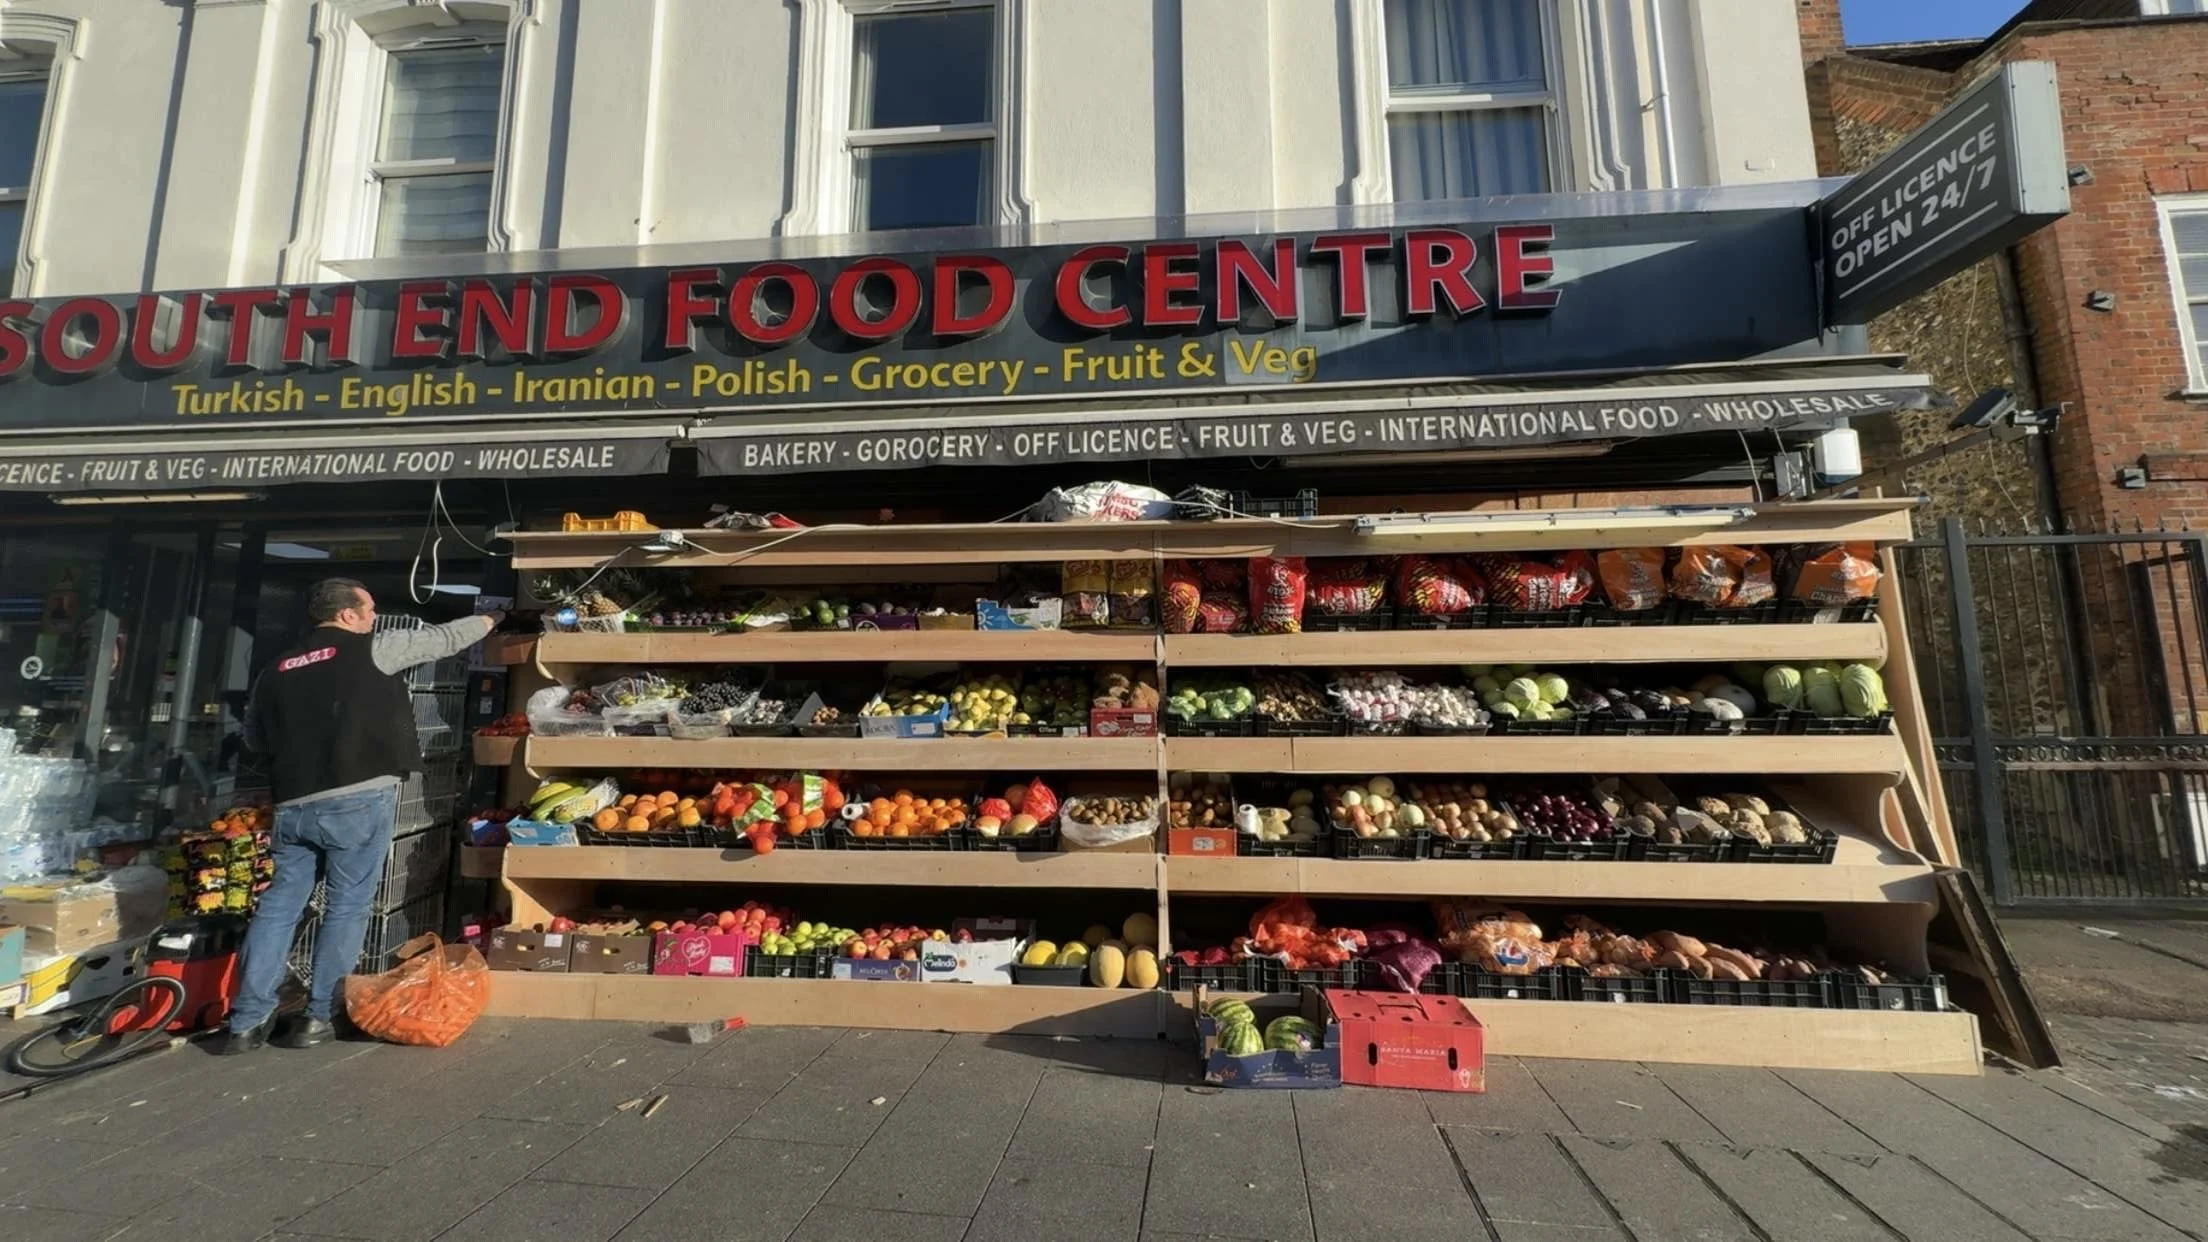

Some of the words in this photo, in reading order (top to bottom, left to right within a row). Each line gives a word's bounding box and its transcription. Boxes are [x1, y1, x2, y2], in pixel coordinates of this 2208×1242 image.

[1831, 206, 1876, 250] OFF
[1881, 122, 1997, 219] LICENCE
[1835, 211, 1913, 278] OPEN
[1921, 156, 1996, 227] 24/7
[0, 289, 355, 377] SOUTH
[394, 274, 626, 359] END
[664, 254, 1018, 350] FOOD
[1054, 224, 1563, 329] CENTRE
[173, 373, 305, 416] Turkish
[339, 369, 478, 418] English
[513, 366, 655, 404] Iranian
[690, 358, 812, 398] Polish
[850, 356, 1026, 397] Grocery
[1062, 343, 1168, 383] Fruit
[1176, 341, 1217, 378] &
[1230, 337, 1317, 385] Veg
[80, 460, 142, 482] FRUIT
[144, 459, 159, 481] &
[166, 457, 206, 480] VEG
[221, 452, 388, 479] INTERNATIONAL
[392, 450, 455, 473] FOOD
[477, 445, 615, 471] WHOLESALE
[743, 440, 837, 467] BAKERY
[856, 434, 988, 463] GOROCERY
[1013, 432, 1060, 457] OFF
[1067, 426, 1175, 454] LICENCE
[1199, 423, 1272, 449] FRUIT
[1280, 422, 1297, 447] &
[1303, 419, 1356, 445] VEG
[1379, 409, 1596, 442] INTERNATIONAL
[1600, 405, 1680, 431] FOOD
[1704, 393, 1894, 424] WHOLESALE
[284, 647, 330, 669] GAZI
